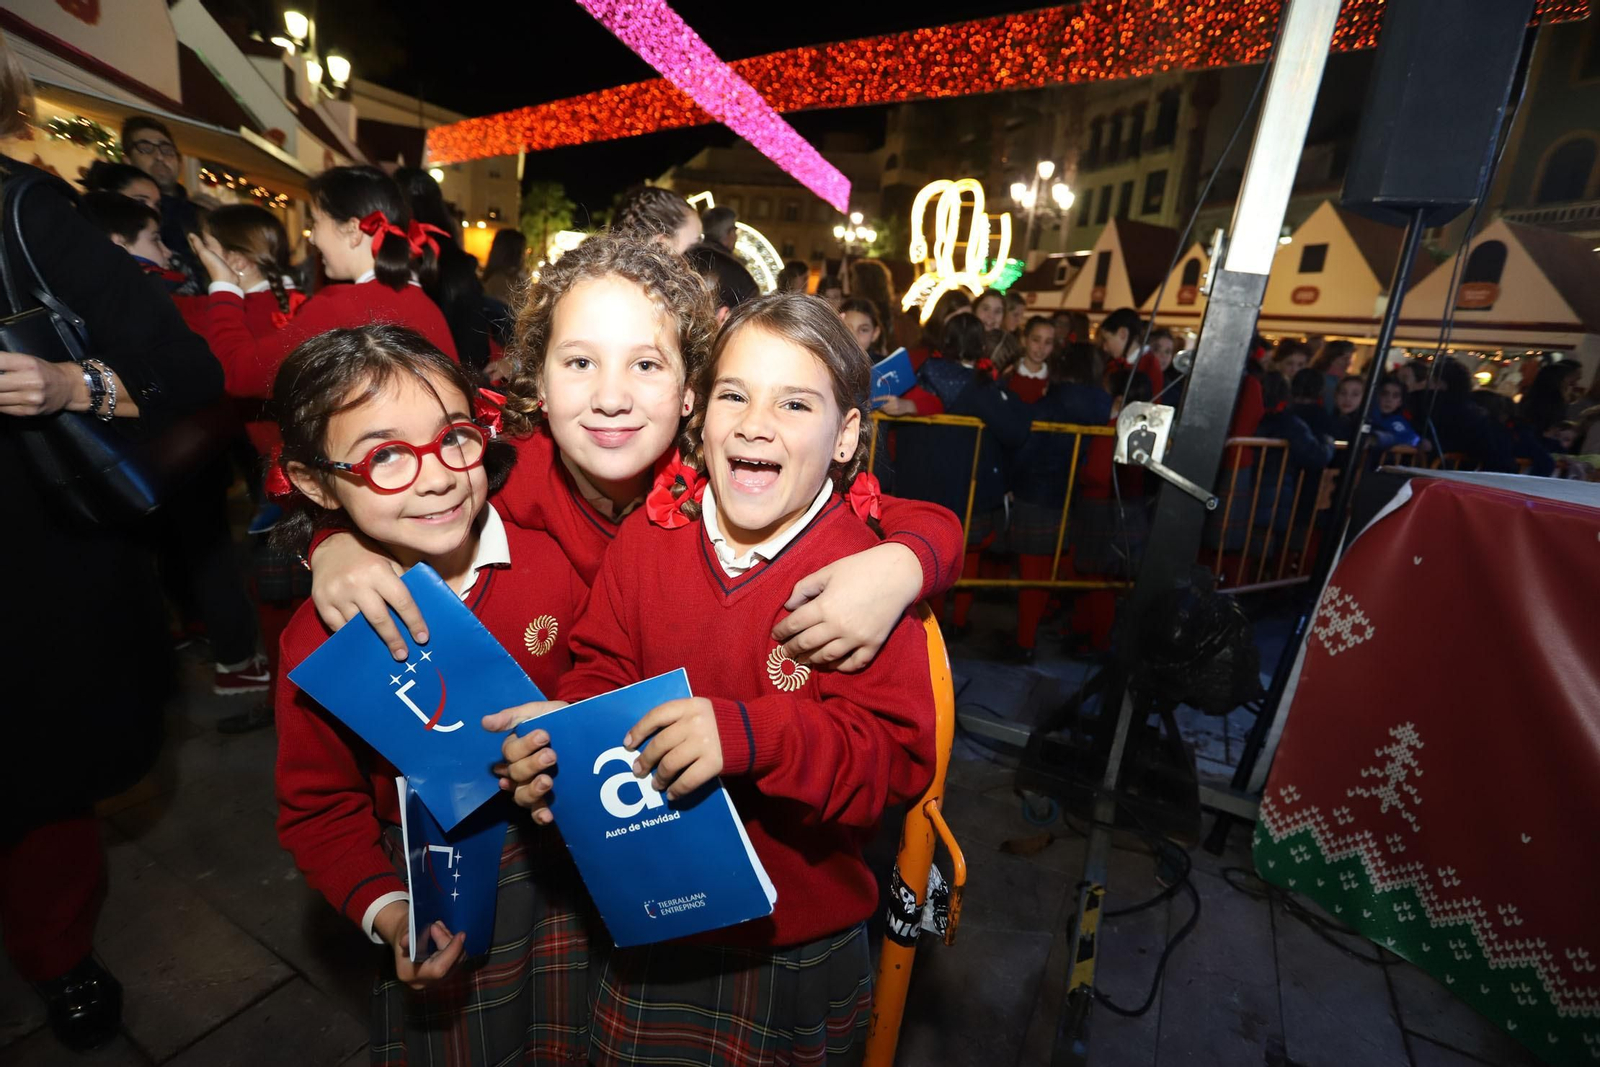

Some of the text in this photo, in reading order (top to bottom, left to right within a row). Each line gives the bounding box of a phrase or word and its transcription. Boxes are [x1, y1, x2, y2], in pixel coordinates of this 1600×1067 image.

[605, 810, 681, 839] Auto de Navidad
[657, 892, 706, 908] TIERRALLANA
[660, 900, 706, 916] ENTREPINOS
